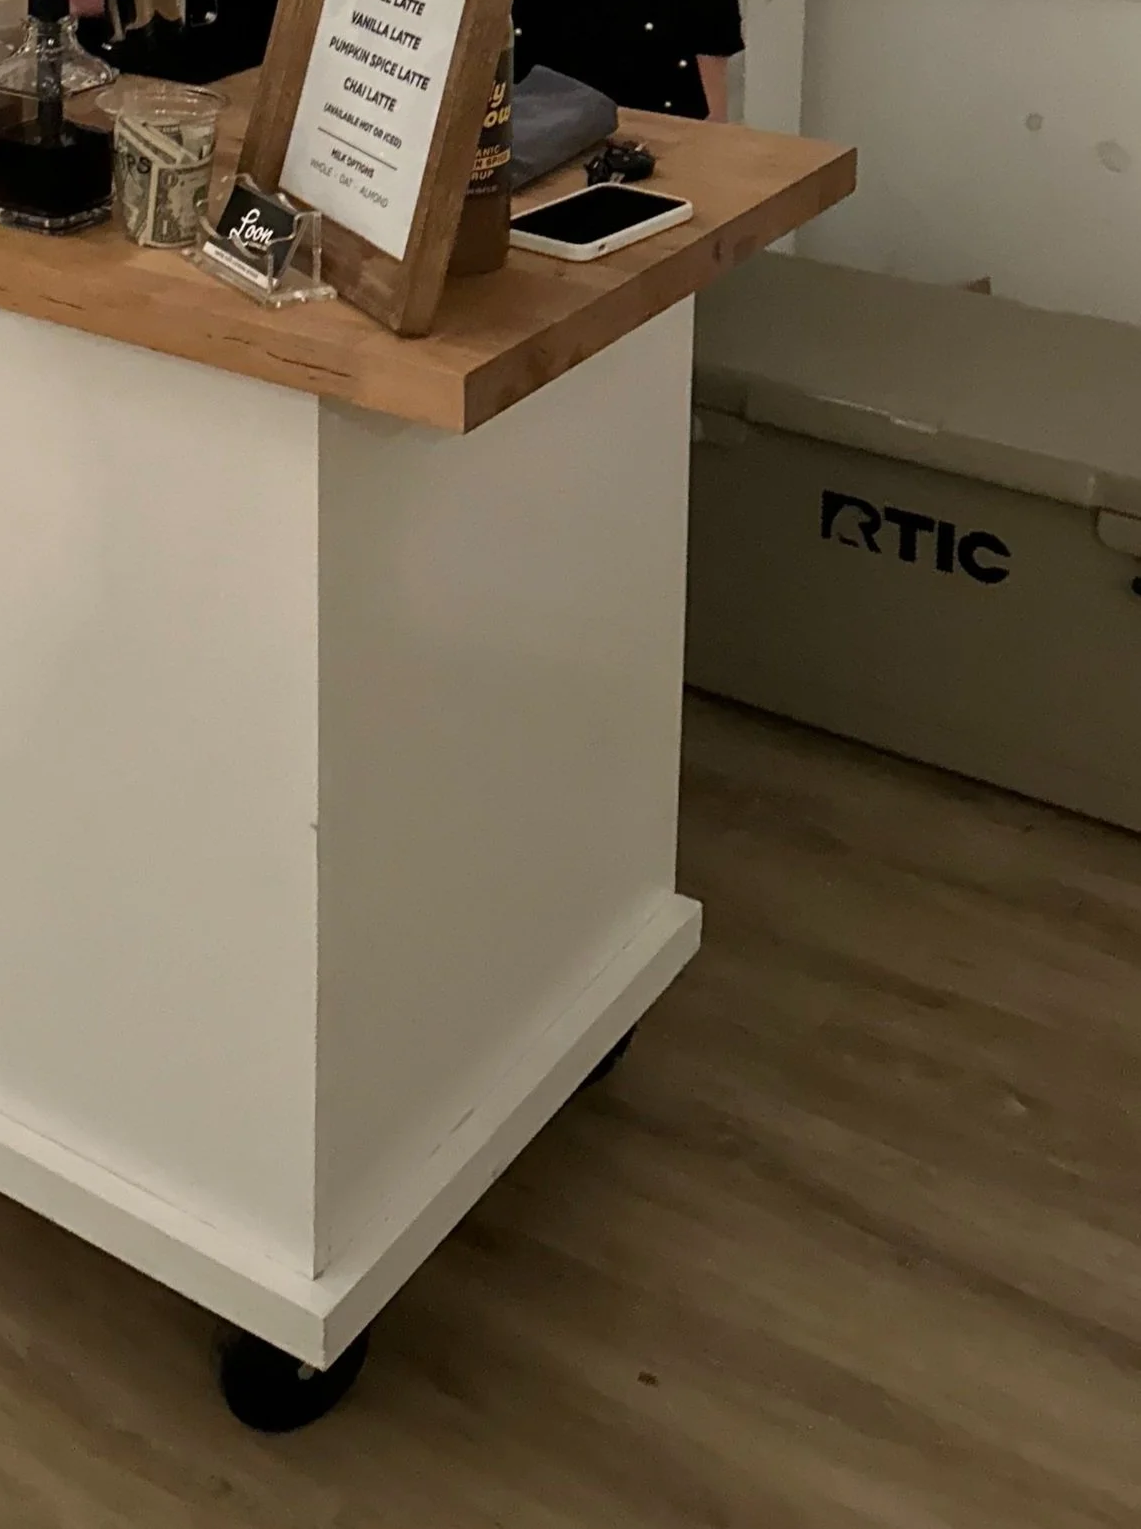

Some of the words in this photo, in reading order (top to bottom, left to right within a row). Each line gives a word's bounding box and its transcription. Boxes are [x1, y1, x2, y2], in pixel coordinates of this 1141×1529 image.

[351, 10, 390, 38] VANILLA
[389, 27, 422, 51] LATTE
[329, 36, 371, 64] PUMPKIN
[369, 53, 398, 77] SPICE
[397, 66, 431, 91] LATTE
[343, 76, 367, 97] CHAI
[365, 87, 398, 112] LATTE
[323, 102, 360, 127] (AVAILABLE
[358, 119, 374, 133] HOT
[373, 126, 384, 139] OR
[383, 132, 402, 149] ICED)
[310, 157, 333, 177] WHOLE
[339, 173, 353, 187] OAT
[359, 185, 389, 208] ALMOND
[331, 147, 347, 162] MILK
[346, 156, 375, 178] OPTIONS
[228, 208, 273, 248] Loon
[821, 489, 1011, 585] RTIC
